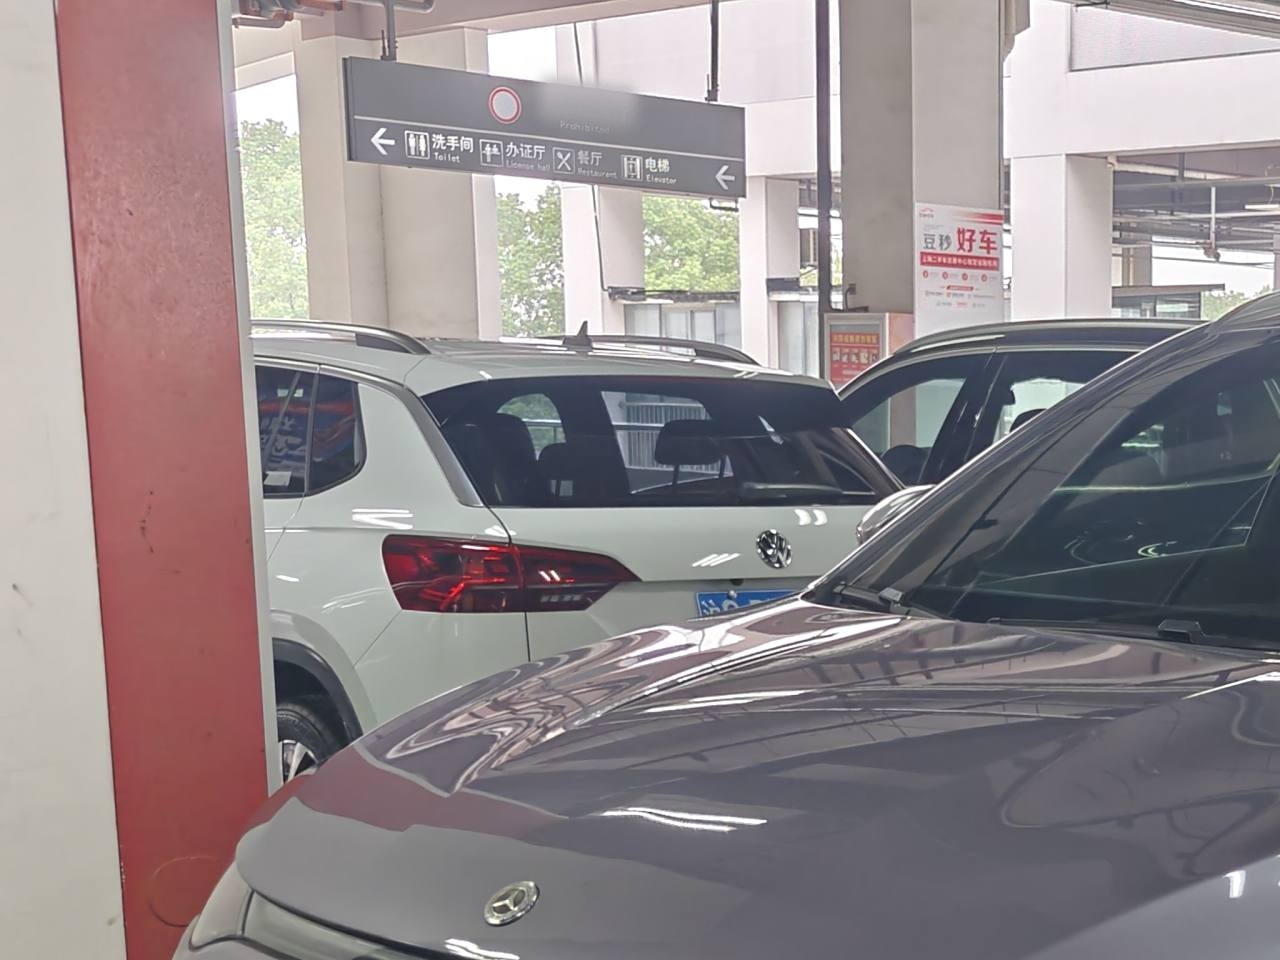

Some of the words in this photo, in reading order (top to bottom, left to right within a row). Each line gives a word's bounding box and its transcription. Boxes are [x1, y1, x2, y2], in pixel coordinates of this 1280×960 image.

[432, 134, 474, 153] 洗手间
[505, 142, 546, 160] 办证厅
[434, 152, 461, 164] Toilet
[577, 150, 603, 167] 餐厅
[645, 156, 671, 173] 电梯
[646, 174, 677, 185] Elevator
